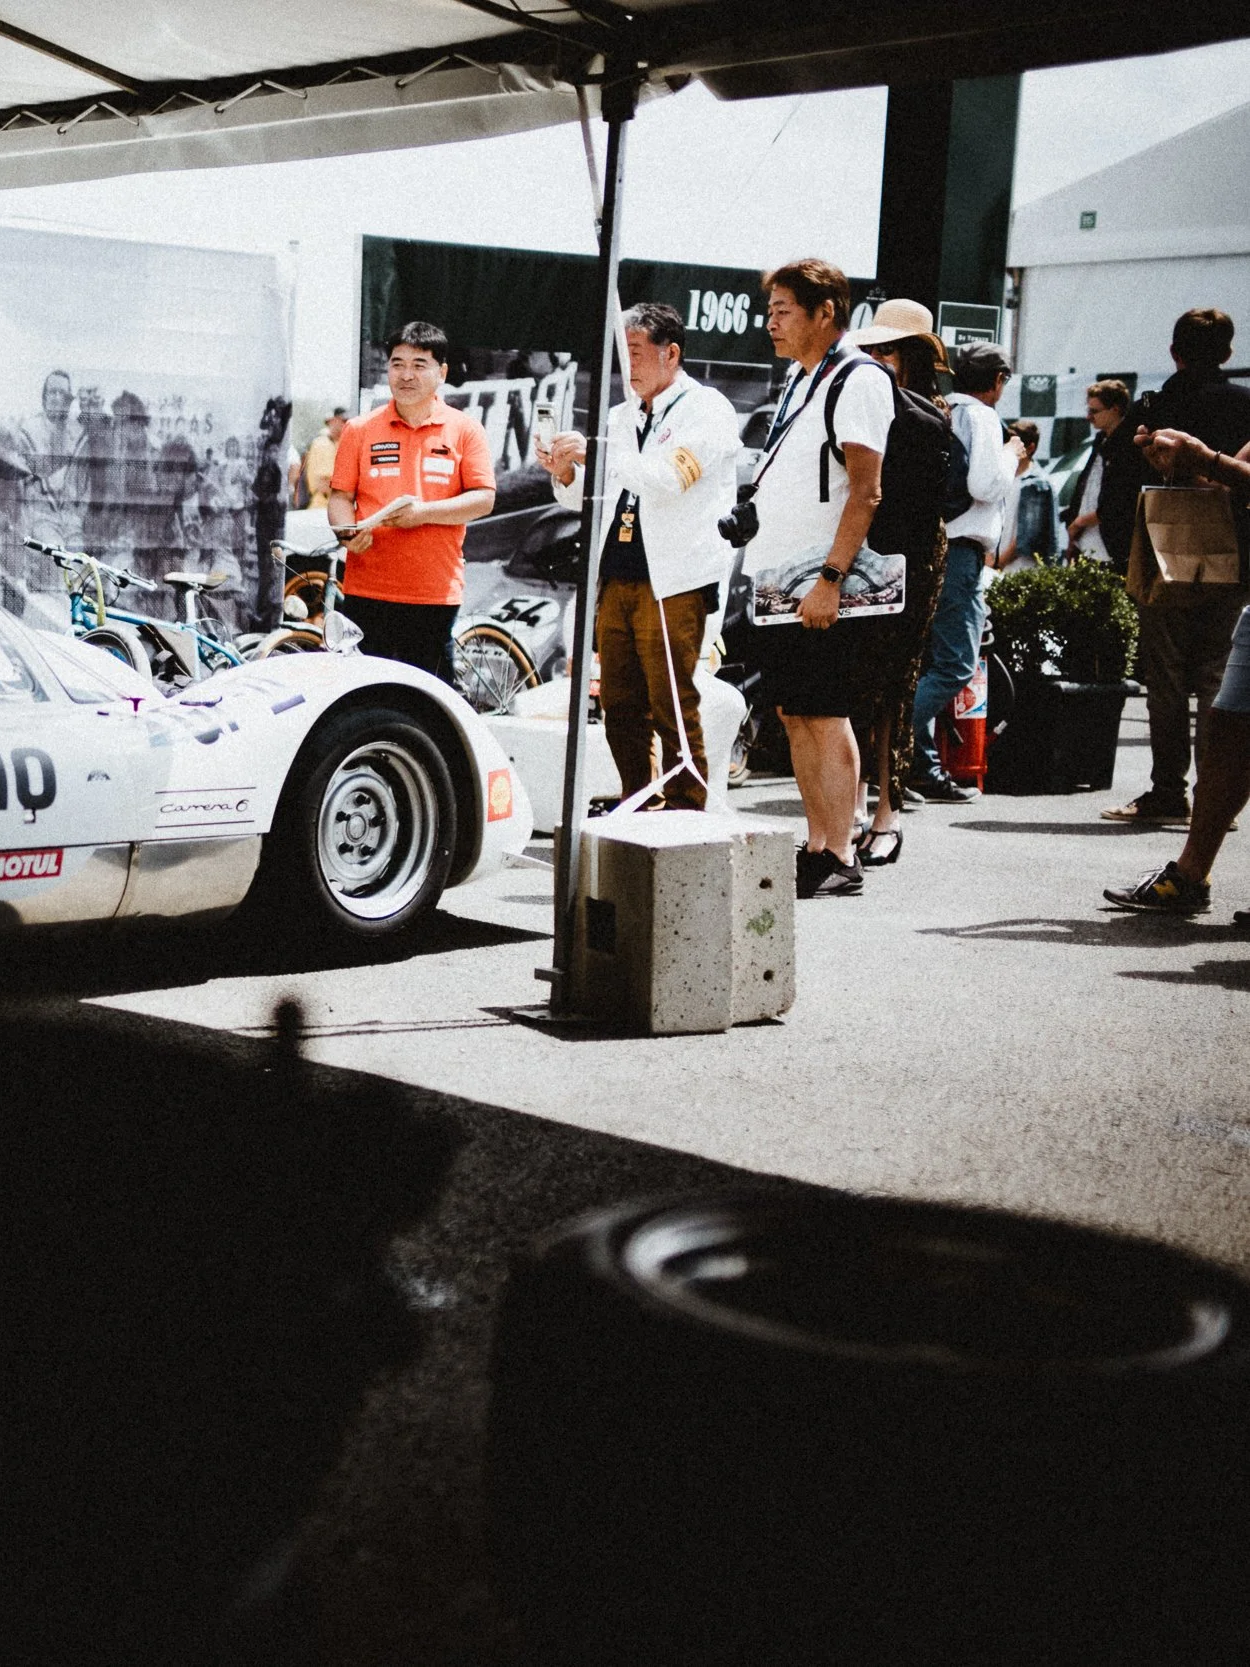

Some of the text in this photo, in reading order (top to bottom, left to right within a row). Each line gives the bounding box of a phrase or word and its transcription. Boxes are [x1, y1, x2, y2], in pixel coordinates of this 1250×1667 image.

[684, 289, 750, 335] 1966
[490, 598, 551, 628] 54
[235, 798, 250, 813] 6
